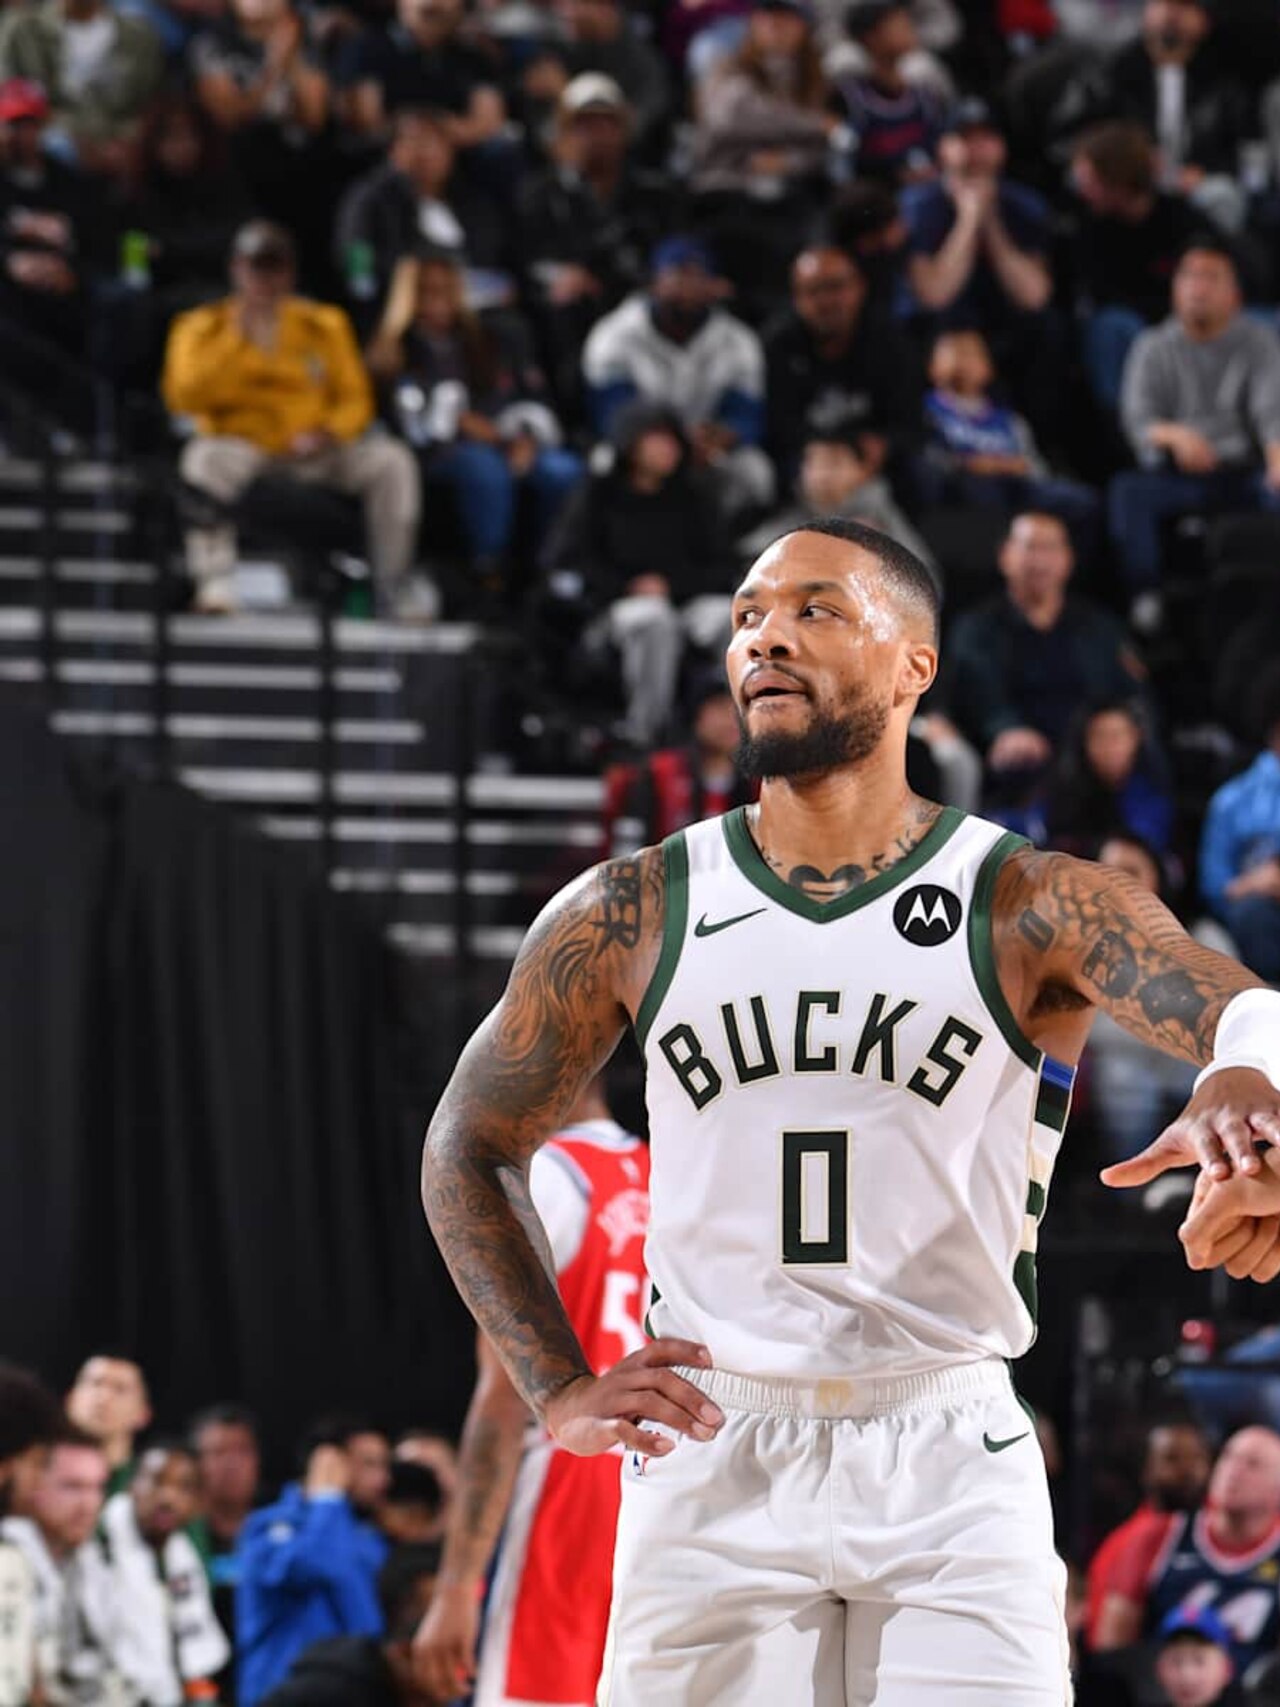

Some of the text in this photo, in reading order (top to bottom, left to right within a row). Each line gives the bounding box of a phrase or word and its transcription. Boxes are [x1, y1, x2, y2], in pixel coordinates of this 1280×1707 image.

[658, 990, 984, 1111] BUCKS
[781, 1130, 849, 1265] 0
[597, 1270, 650, 1376] 5
